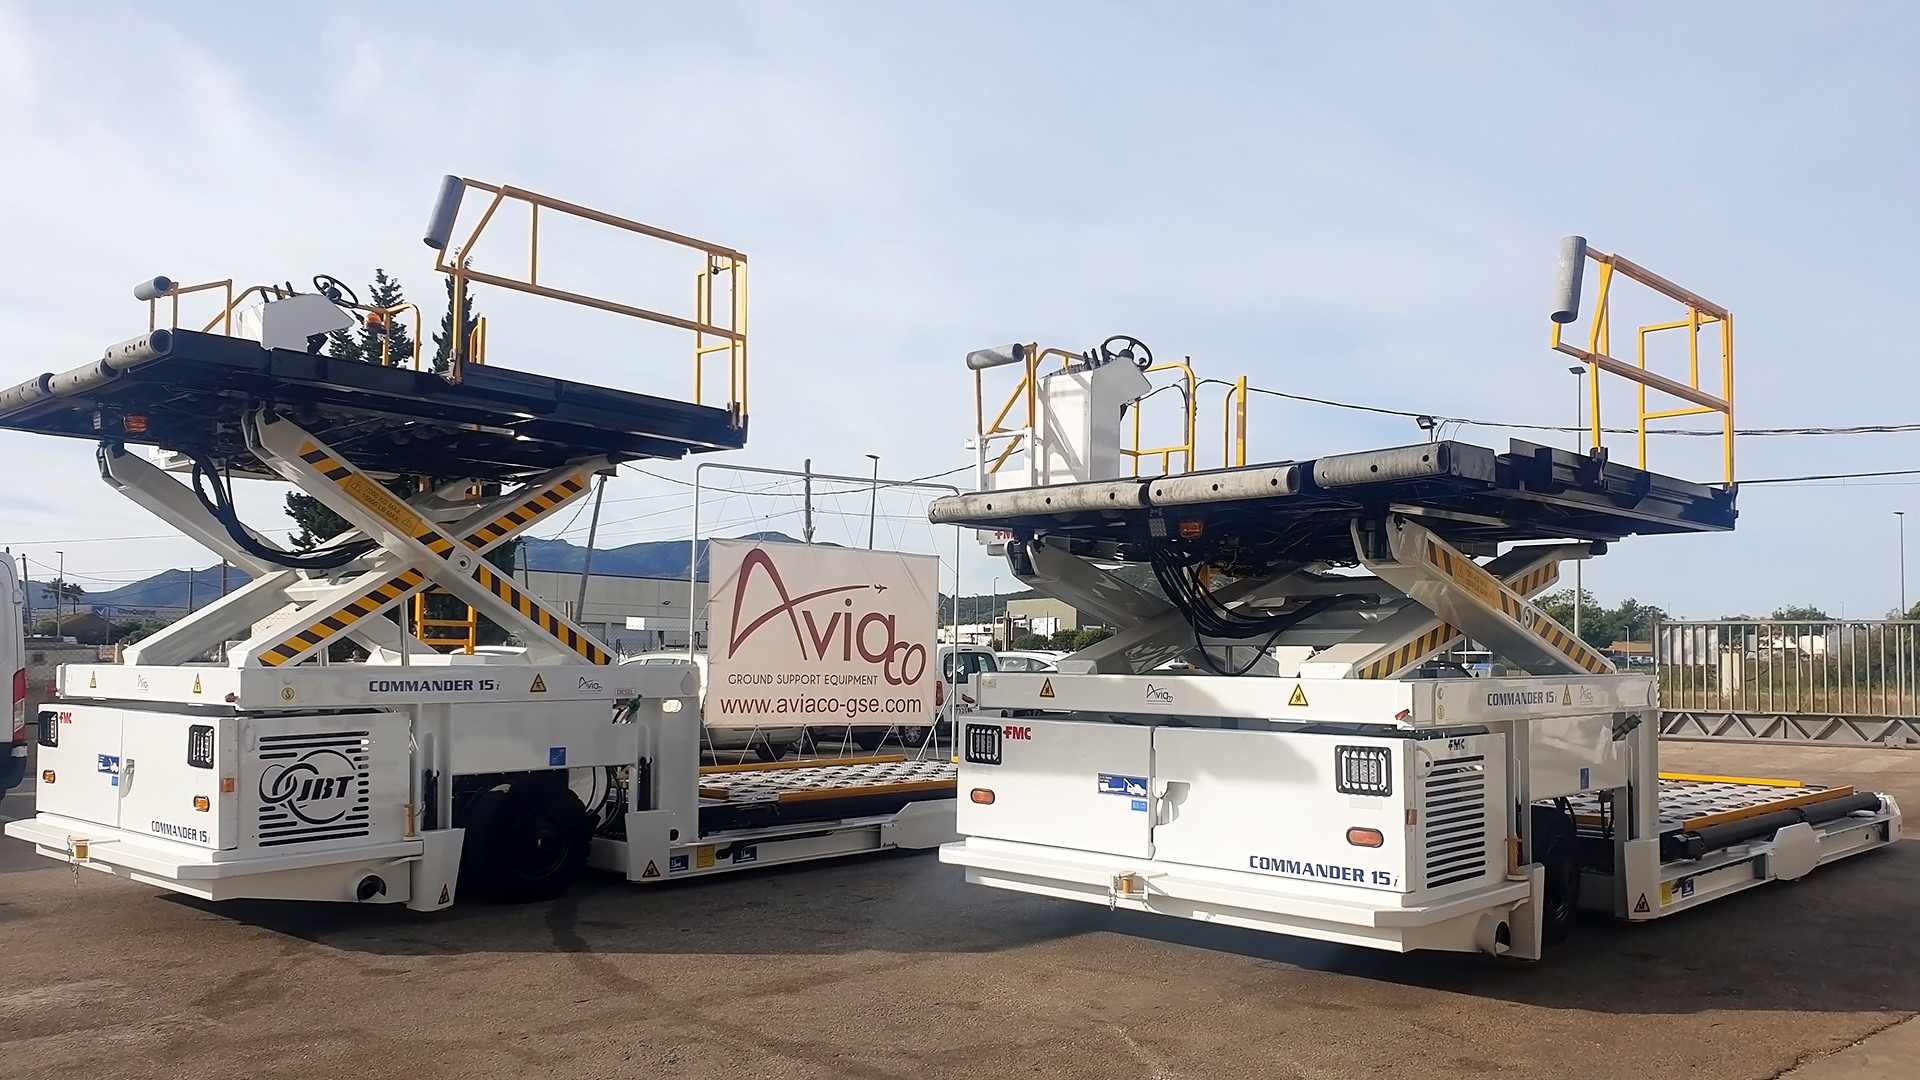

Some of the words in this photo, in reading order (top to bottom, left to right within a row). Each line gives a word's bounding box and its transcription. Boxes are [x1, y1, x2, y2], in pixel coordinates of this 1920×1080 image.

[728, 547, 927, 686] Aviaco
[368, 680, 474, 692] COMMANDER
[728, 673, 774, 685] GROUND
[776, 674, 821, 685] SUPPORT
[824, 674, 878, 686] EQUIPMENT
[720, 693, 922, 718] www.aviaco-gse.com
[1487, 691, 1544, 706] COMMANDER
[59, 711, 72, 725] FMC
[1003, 725, 1032, 740] FMC
[1447, 738, 1466, 751] FMC
[297, 775, 355, 802] JBT
[151, 820, 198, 842] COMMANDER
[1249, 855, 1365, 883] COMMANDER
